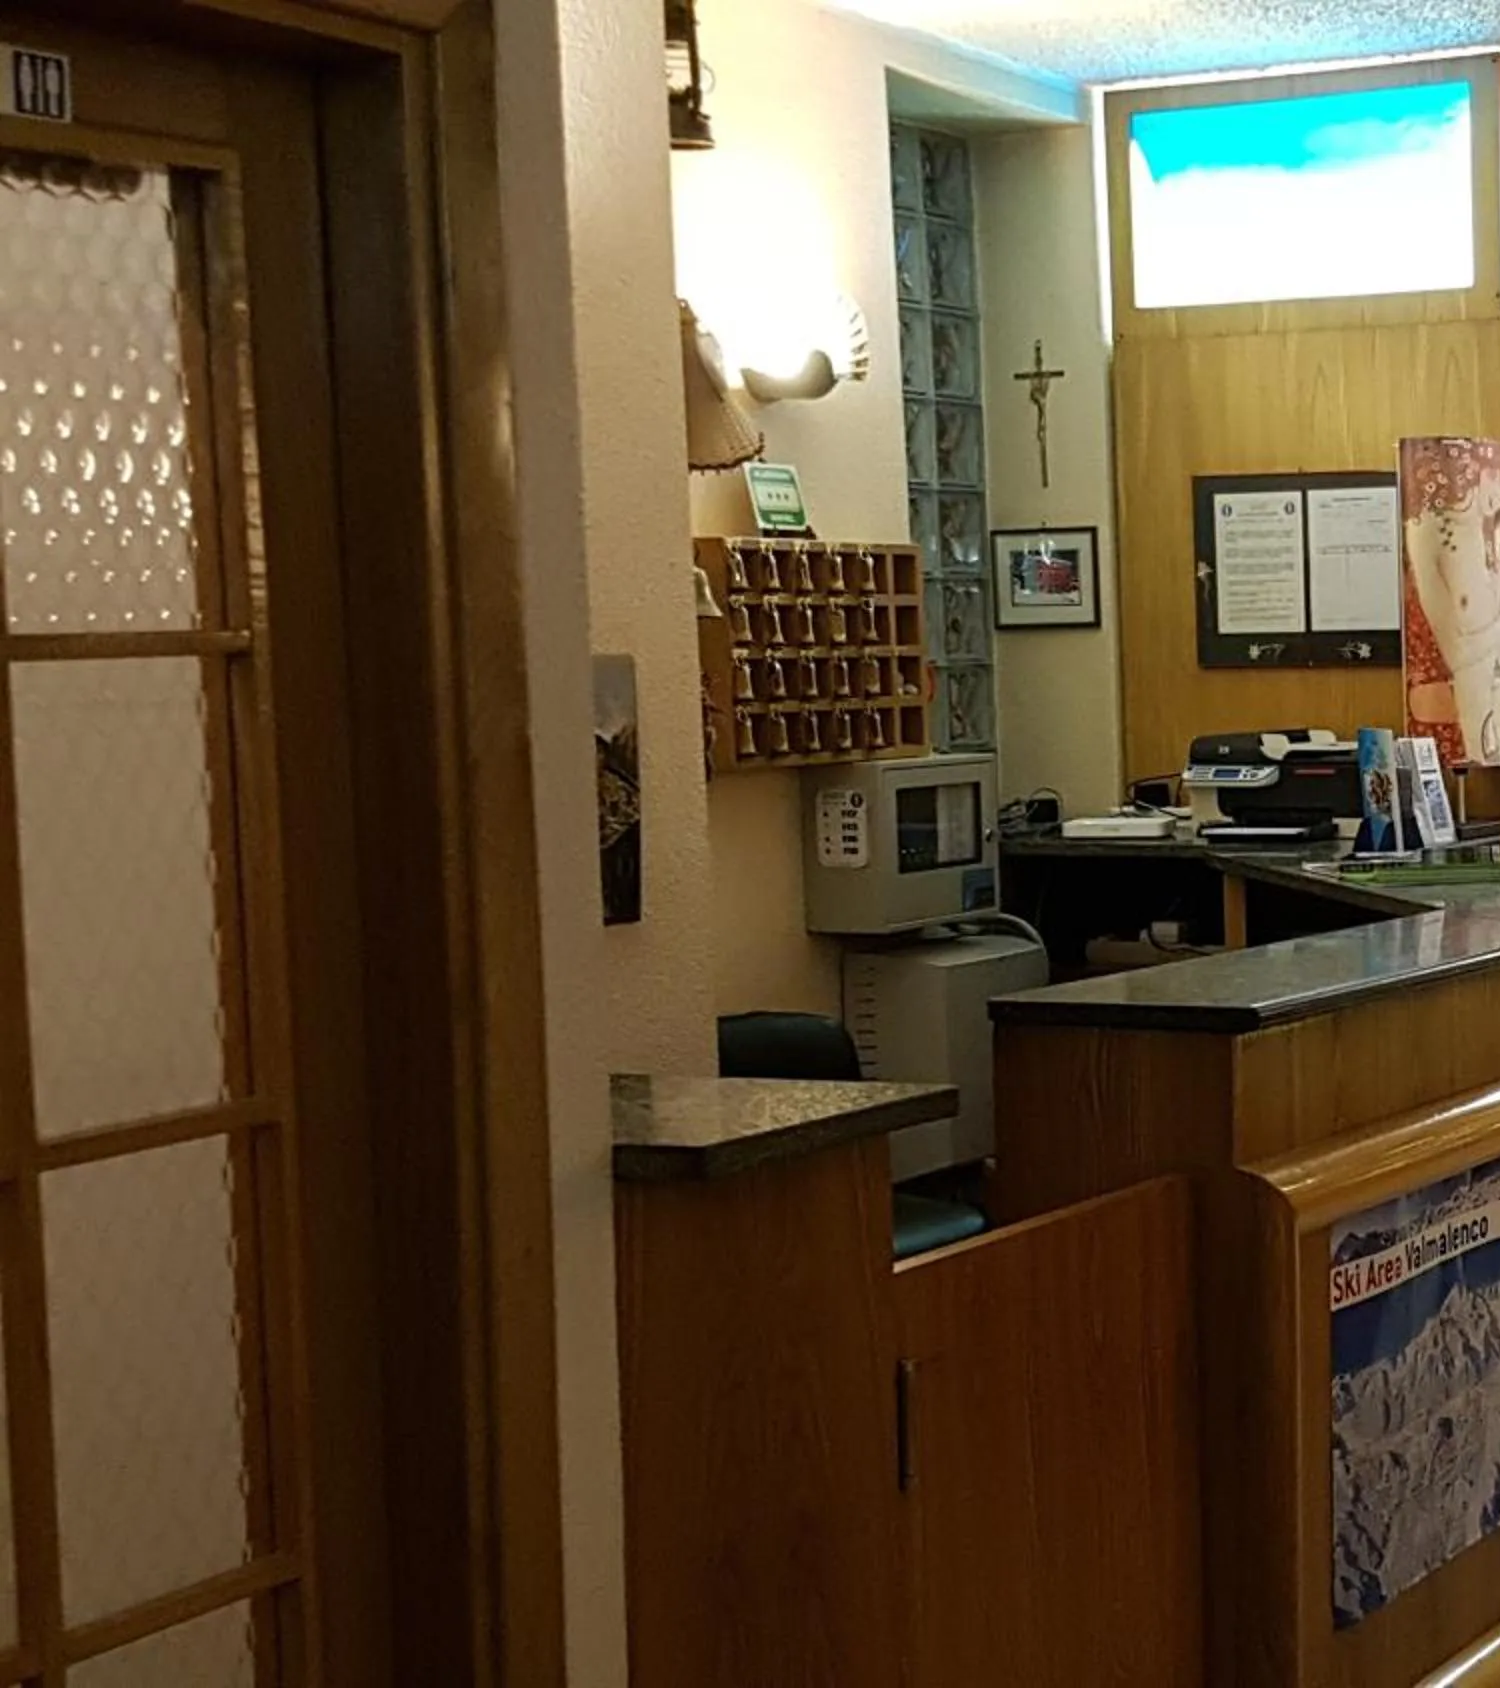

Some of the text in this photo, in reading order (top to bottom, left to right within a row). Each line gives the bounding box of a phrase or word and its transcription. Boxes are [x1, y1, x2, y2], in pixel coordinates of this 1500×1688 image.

[1333, 1216, 1489, 1304] Ski Area Valmalenco
